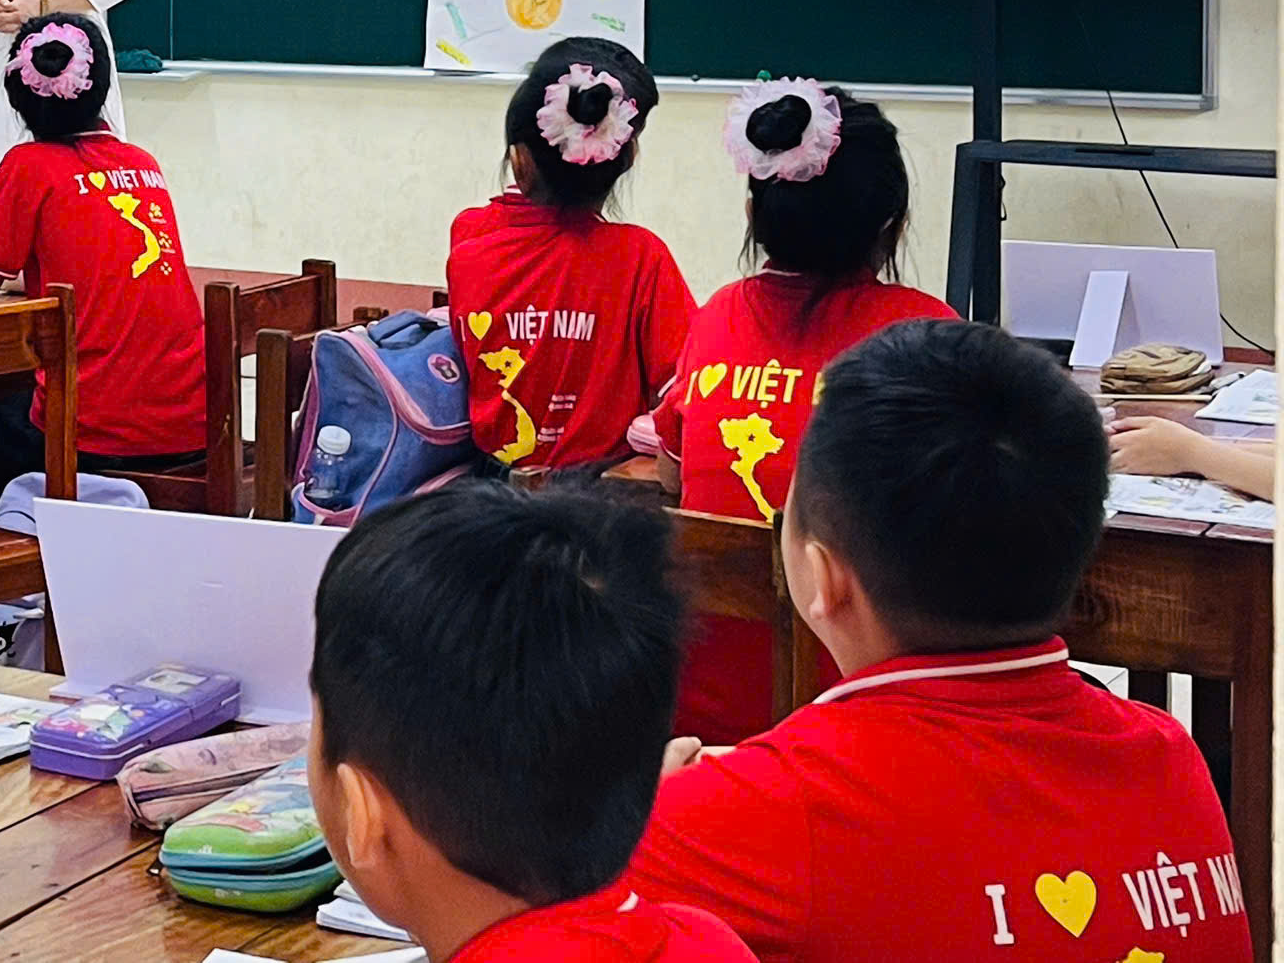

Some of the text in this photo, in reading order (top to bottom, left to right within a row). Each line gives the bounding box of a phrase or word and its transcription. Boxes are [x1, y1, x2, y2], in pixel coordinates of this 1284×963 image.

[74, 174, 88, 194] I
[107, 166, 140, 191] VIỆT
[505, 304, 548, 345] VIỆT
[553, 310, 595, 341] NAM
[732, 358, 803, 408] VIỆT
[984, 884, 1015, 945] I
[1122, 851, 1205, 938] VIỆT
